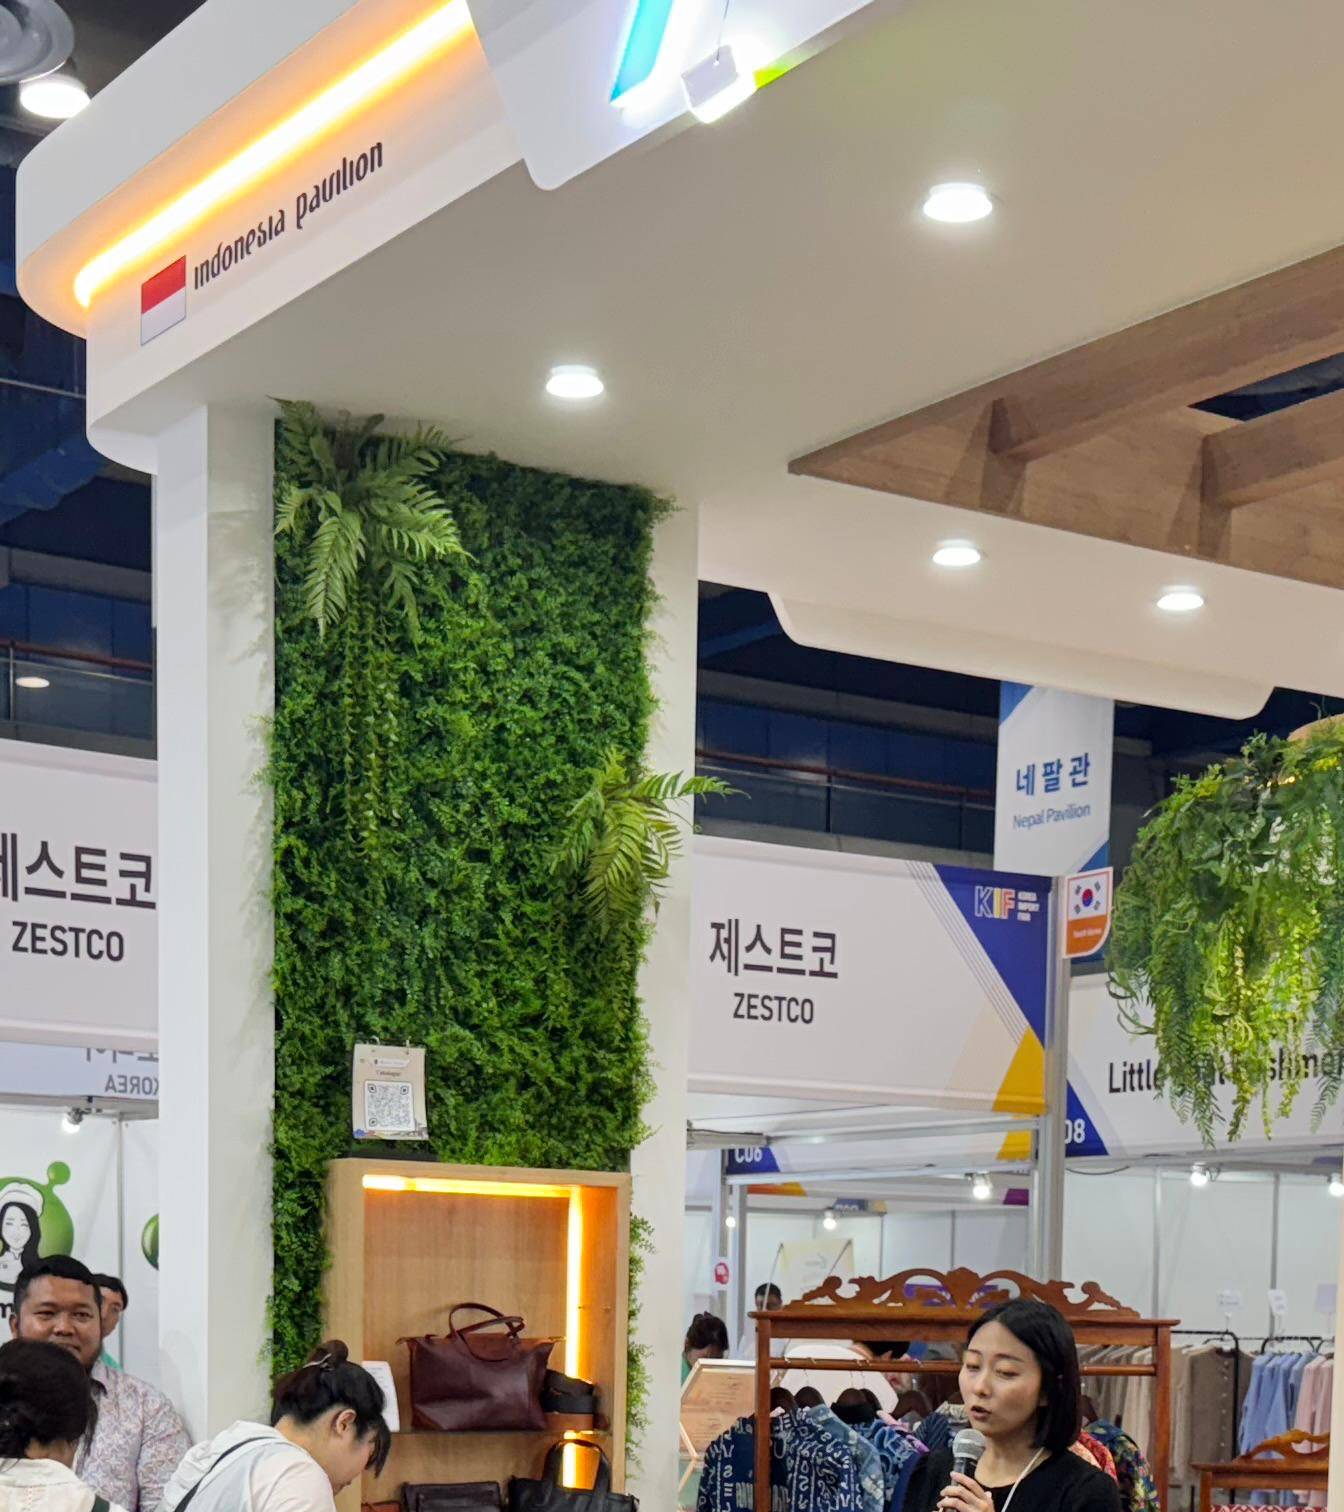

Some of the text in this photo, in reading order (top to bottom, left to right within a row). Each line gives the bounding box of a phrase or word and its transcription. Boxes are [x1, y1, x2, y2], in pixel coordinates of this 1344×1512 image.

[1013, 803, 1091, 833] Nepal Pavilion
[974, 885, 1016, 920] KIF
[12, 921, 125, 963] ZESTCO
[709, 918, 839, 980] 제스트코
[733, 992, 814, 1026] ZESTCO
[1109, 1059, 1157, 1093] Littl
[1064, 1118, 1086, 1144] 08
